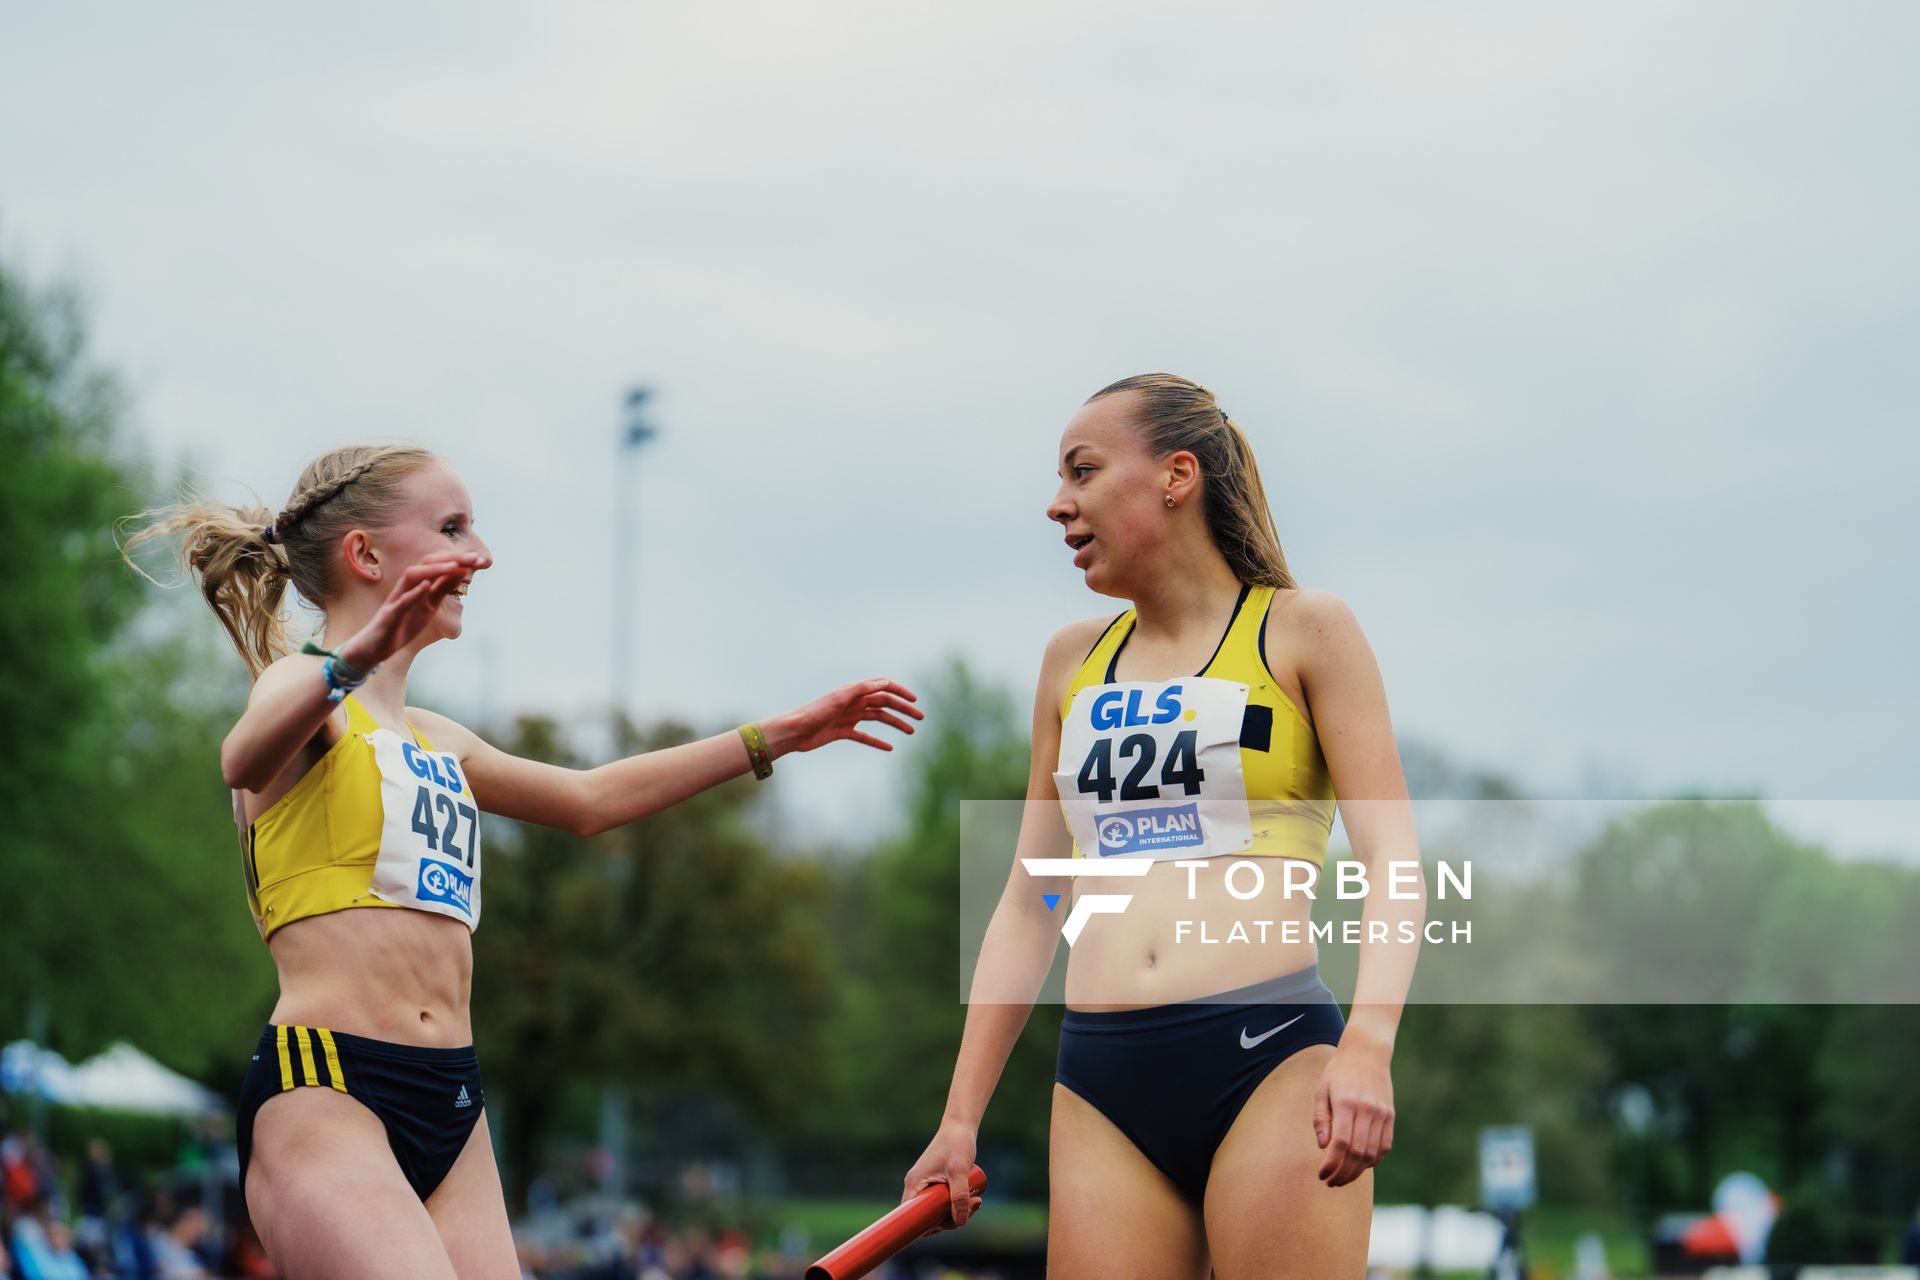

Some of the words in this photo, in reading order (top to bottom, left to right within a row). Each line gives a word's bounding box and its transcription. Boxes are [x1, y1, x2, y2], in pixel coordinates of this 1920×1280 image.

[1077, 730, 1205, 804] 424
[412, 785, 476, 869] 427
[1137, 813, 1196, 835] PLAN
[1139, 833, 1199, 845] INTERNATIONAL
